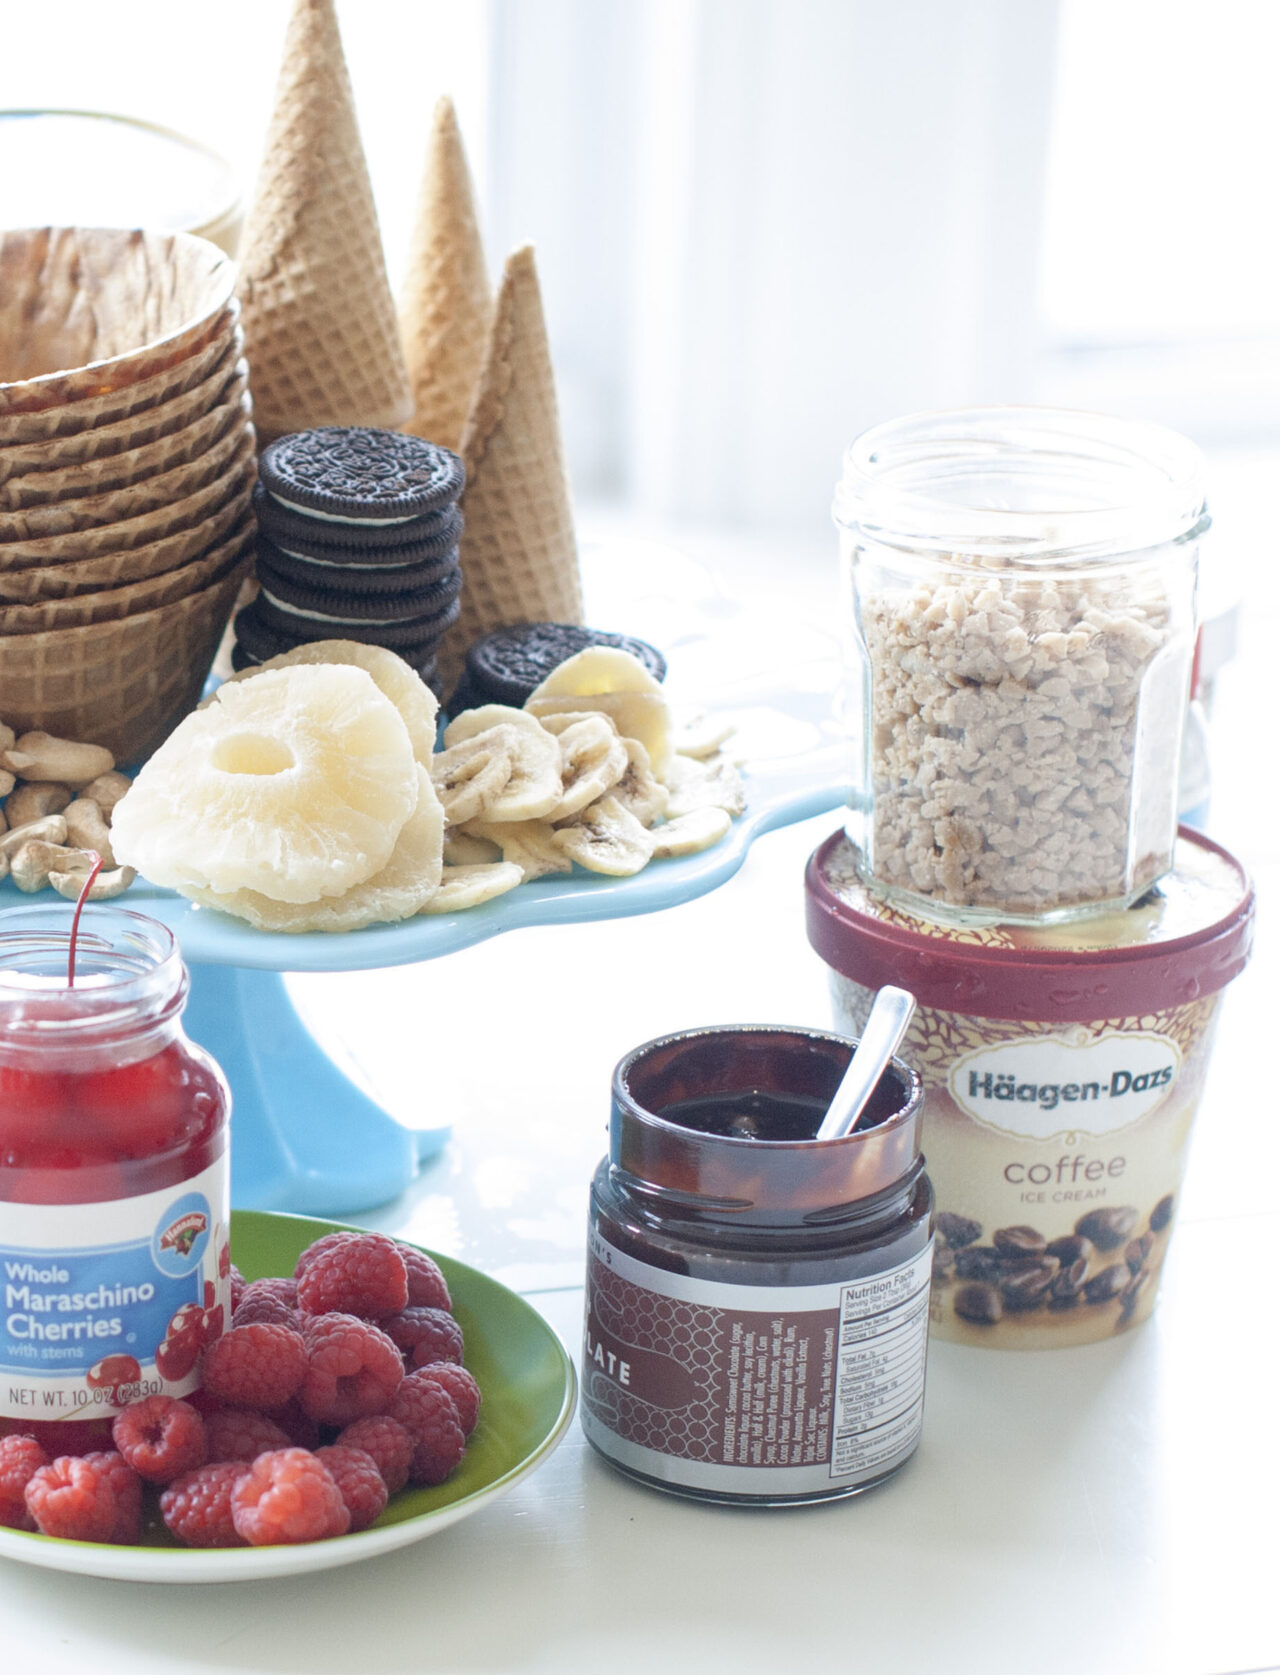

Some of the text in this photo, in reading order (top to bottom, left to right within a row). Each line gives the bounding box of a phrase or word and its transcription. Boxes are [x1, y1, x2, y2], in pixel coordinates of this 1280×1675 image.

[969, 1065, 1173, 1111] Häagen-Dazs
[1004, 1154, 1126, 1185] coffee
[1020, 1188, 1106, 1204] ICE CREAM
[4, 1261, 69, 1284] Whole
[846, 1281, 891, 1300] Nutrition
[894, 1268, 915, 1286] Facts
[5, 1282, 154, 1313] Maraschino
[845, 1298, 869, 1309] Serving
[845, 1306, 871, 1319] Servings
[5, 1313, 122, 1341] Cherries
[843, 1331, 867, 1342] Calories
[7, 1344, 84, 1360] with stems
[727, 1346, 740, 1377] Chocolate
[744, 1357, 755, 1368] soy
[9, 1388, 37, 1406] NET
[43, 1390, 67, 1407] WT.
[72, 1390, 88, 1406] 10
[93, 1387, 114, 1404] OZ
[742, 1392, 751, 1410] cocoa
[724, 1415, 736, 1462] INGREDIENTS:
[736, 1434, 749, 1463] chocolate
[776, 1444, 789, 1464] Cocoa
